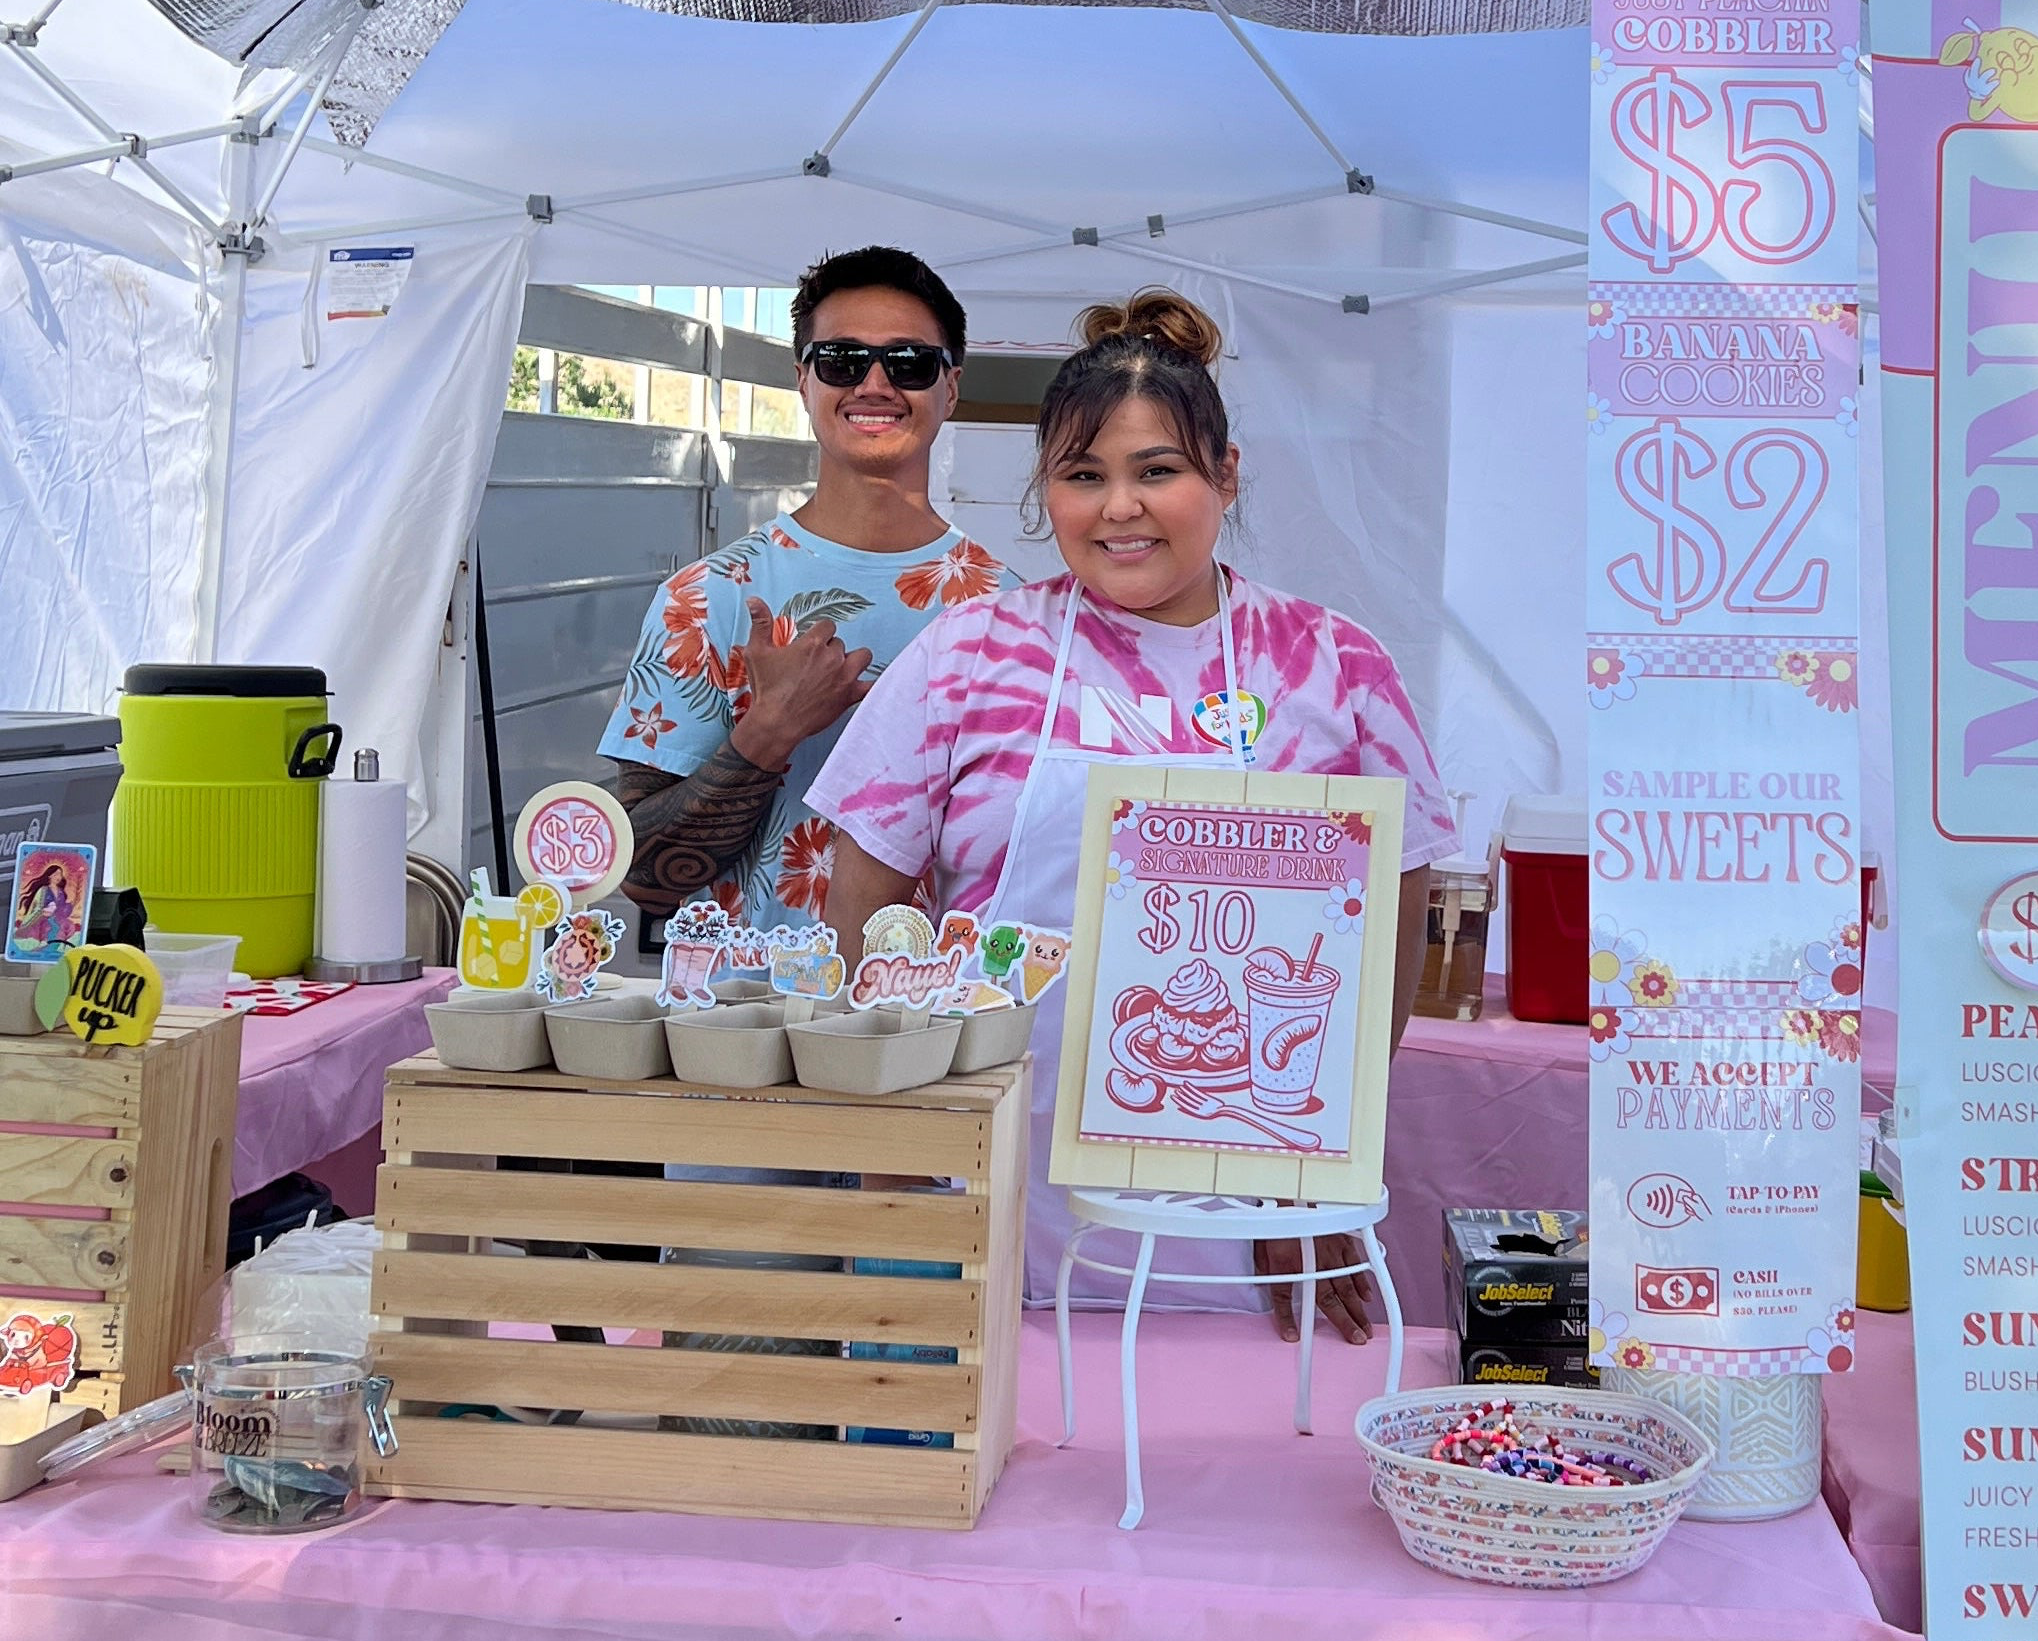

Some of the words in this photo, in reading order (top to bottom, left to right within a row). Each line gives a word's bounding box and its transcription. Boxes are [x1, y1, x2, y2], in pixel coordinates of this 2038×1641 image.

[1612, 15, 1836, 55] COBBLER
[1601, 66, 1836, 274] $5
[1620, 322, 1825, 361] BANANA
[1619, 363, 1825, 408] COOKIES
[1607, 416, 1829, 626] $2
[1602, 769, 1752, 801] SAMPLE
[1759, 772, 1843, 802] OUR
[540, 813, 605, 873] $3
[1140, 815, 1308, 854] COBBLER
[1315, 821, 1343, 854] &
[1594, 808, 1855, 885] SWEETS
[1139, 848, 1271, 880] SIGNATURE
[1277, 855, 1346, 883] DRINK
[1138, 883, 1256, 955] $10
[71, 956, 146, 1019] PUCKER
[1626, 1060, 1680, 1087] WE
[1688, 1060, 1819, 1088] ACCEPT
[1962, 1062, 2038, 1083] LUSCI
[1616, 1086, 1837, 1131] PAYMENTS
[1963, 1215, 2038, 1237] LUSCI
[1479, 1283, 1554, 1301] JobSelect
[1733, 1269, 1778, 1284] CASH
[1755, 1288, 1784, 1298] BILLS
[1787, 1286, 1813, 1296] OVER
[1475, 1363, 1549, 1383] JobSelect
[1965, 1370, 2038, 1392] BLUSH
[197, 1400, 271, 1433] Bloom
[1963, 1427, 2038, 1462] SU
[1964, 1486, 2033, 1508] JUICY
[1965, 1526, 2038, 1548] FRESH
